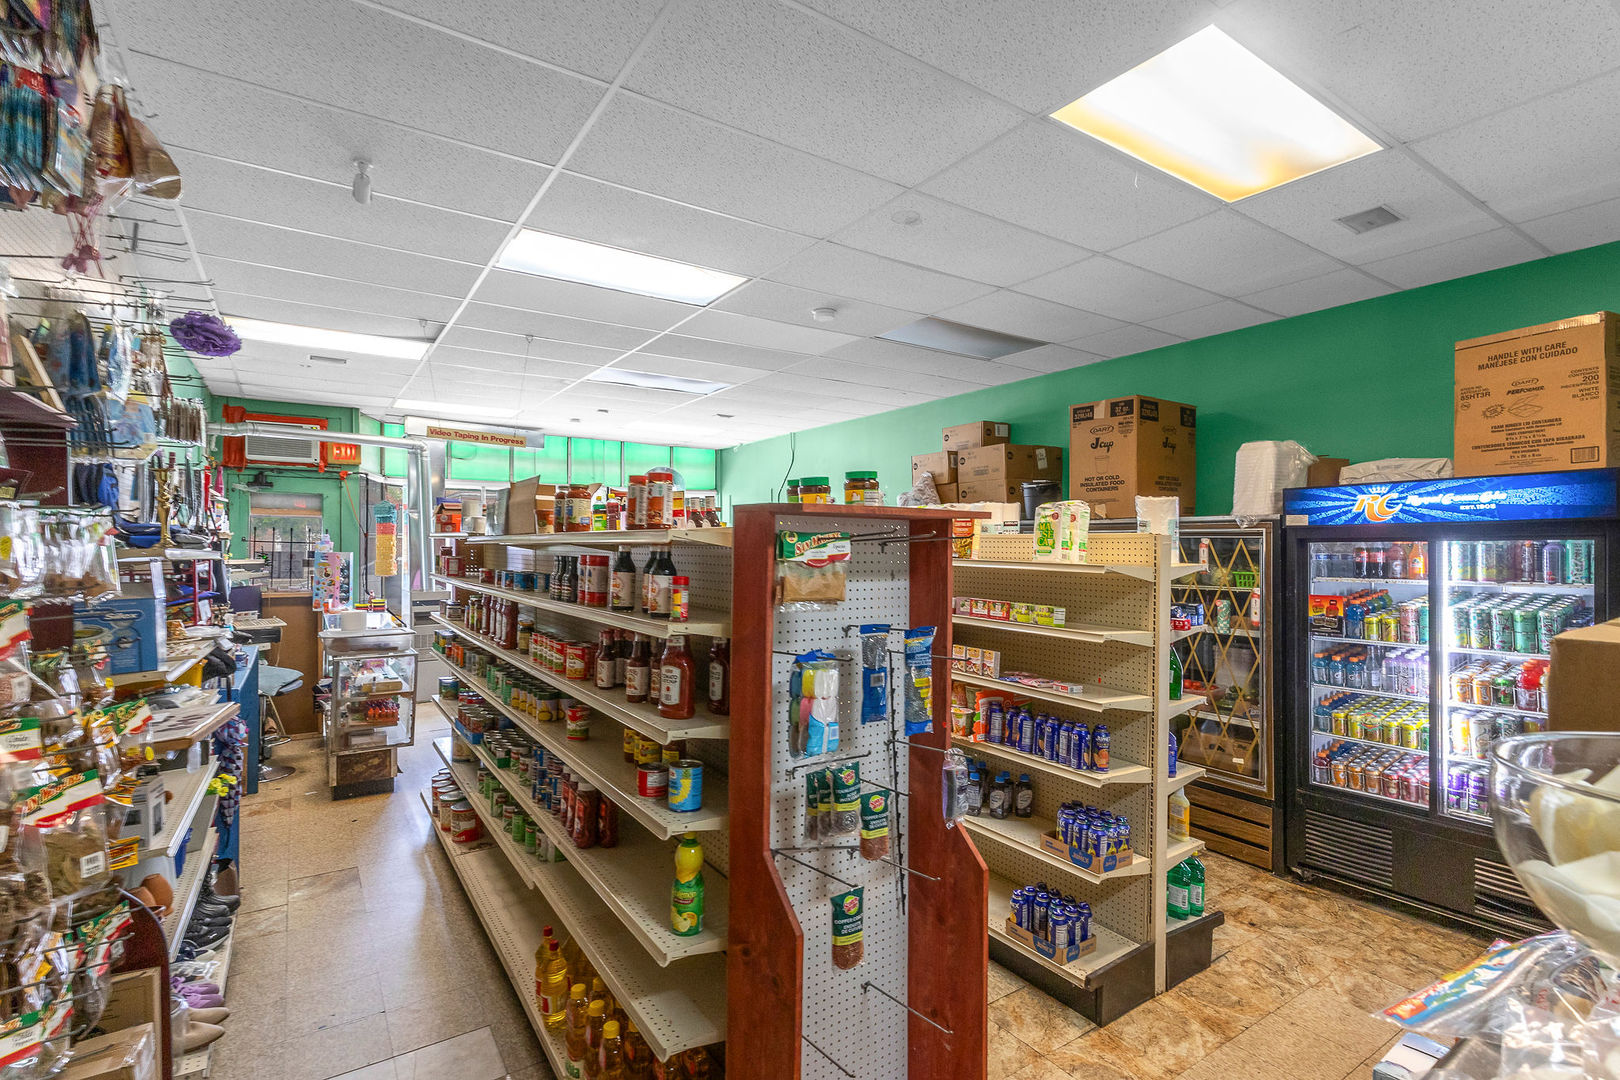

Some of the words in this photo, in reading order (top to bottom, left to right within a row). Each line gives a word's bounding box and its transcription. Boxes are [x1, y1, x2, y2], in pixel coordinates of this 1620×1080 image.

[1487, 350, 1519, 362] HANDLE
[1520, 346, 1542, 356] WITH
[1544, 341, 1567, 352] CARE
[1520, 354, 1537, 364] CON
[1539, 346, 1578, 360] CUIDADO
[1582, 374, 1600, 382] 200
[429, 428, 452, 437] Video
[454, 431, 480, 441] Taping
[490, 435, 524, 445] Progress
[332, 445, 356, 459] EXIT
[1080, 480, 1109, 488] INSULATED
[1352, 492, 1402, 522] RC
